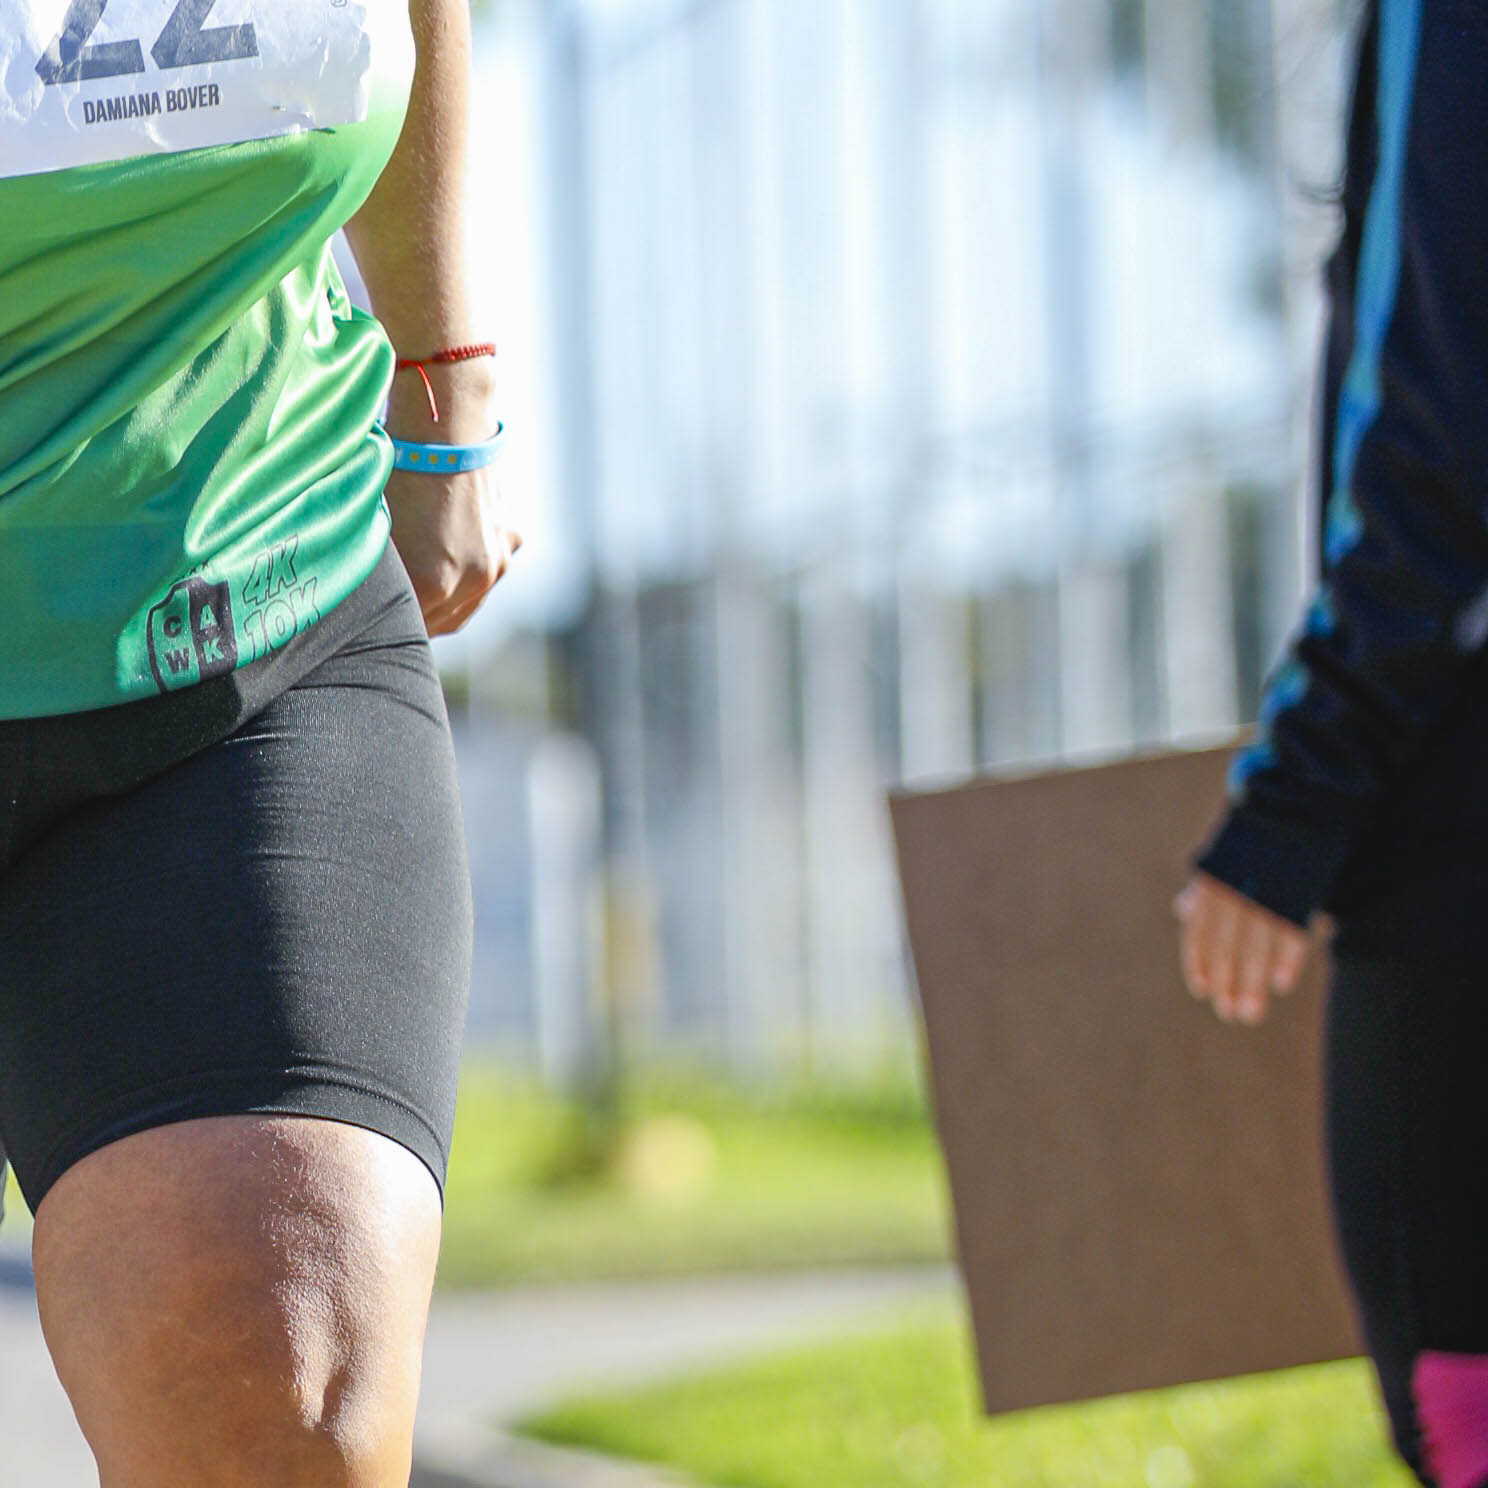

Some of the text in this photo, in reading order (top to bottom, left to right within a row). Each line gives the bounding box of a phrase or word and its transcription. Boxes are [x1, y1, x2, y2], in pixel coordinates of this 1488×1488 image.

[83, 83, 220, 124] DAMIANA BOVER
[242, 534, 299, 606] 4K
[163, 615, 182, 639] C
[163, 647, 190, 674] W
